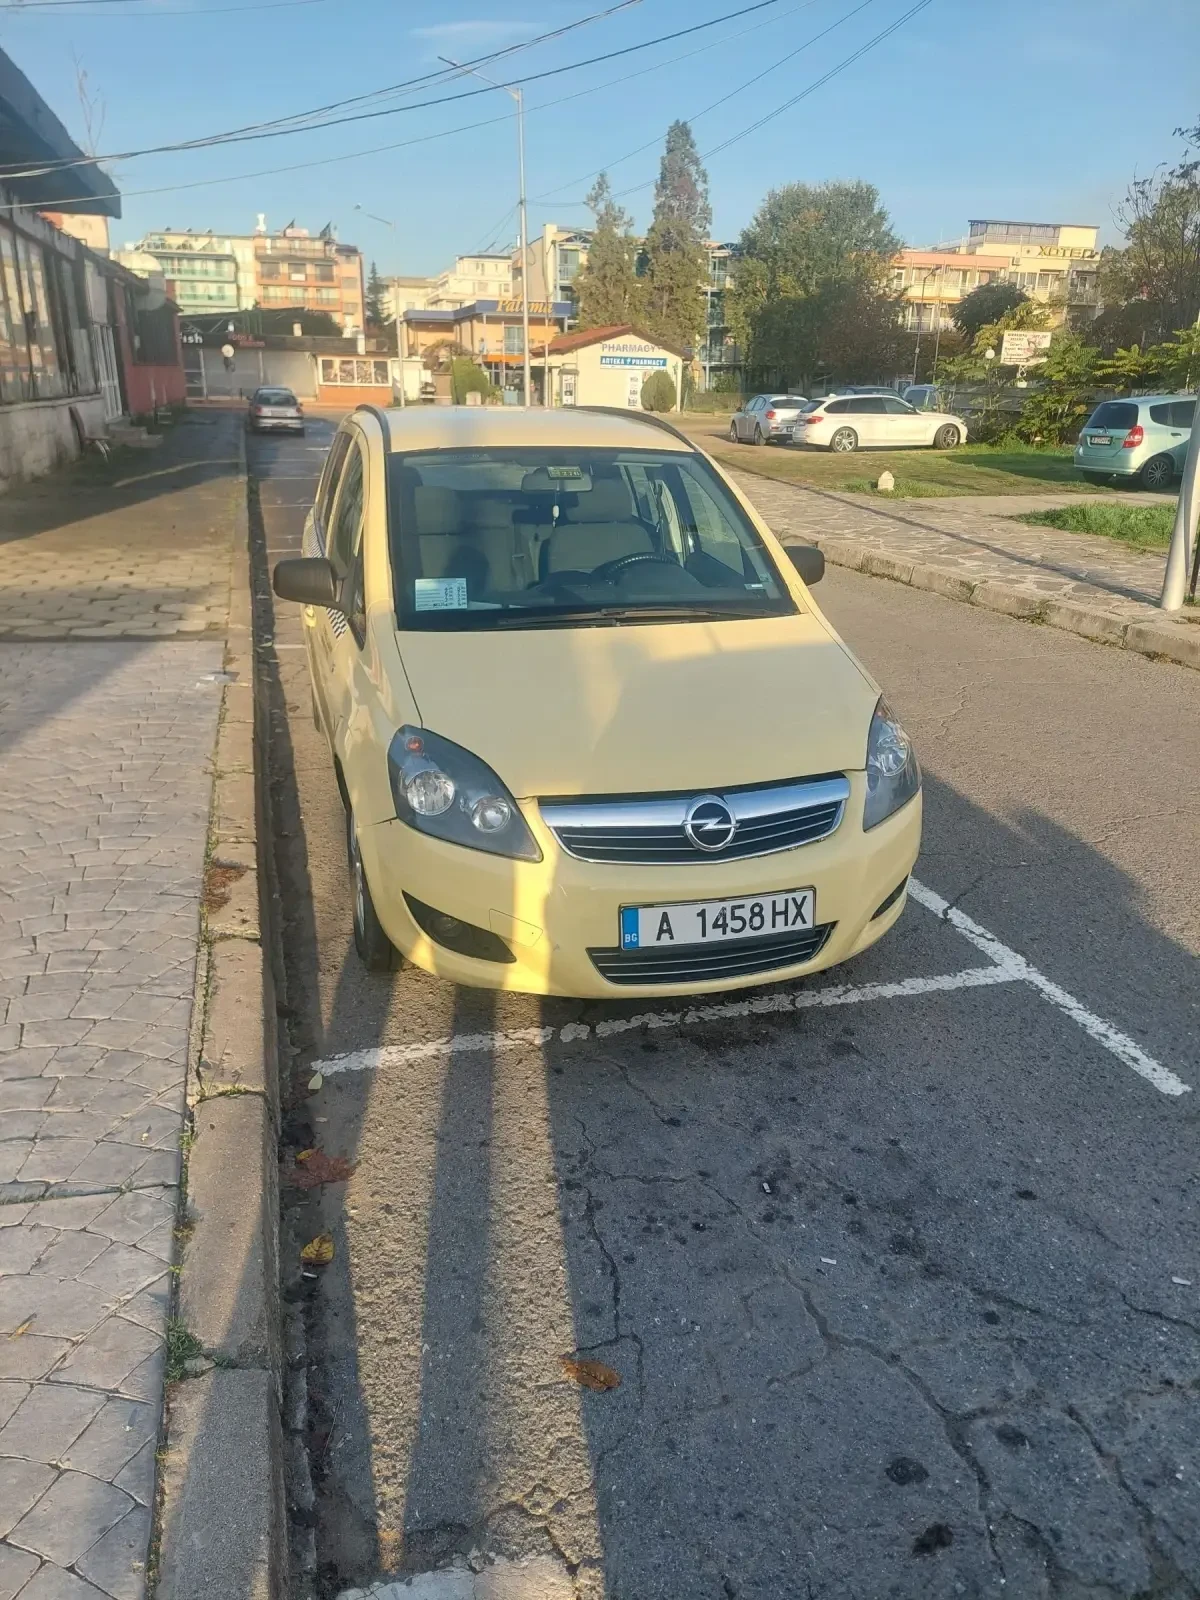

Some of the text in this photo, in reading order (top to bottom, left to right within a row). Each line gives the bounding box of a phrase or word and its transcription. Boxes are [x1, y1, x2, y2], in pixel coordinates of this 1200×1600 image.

[496, 294, 553, 313] Palma
[602, 343, 656, 353] PHARMACY
[602, 357, 664, 366] АПТЕКА PHARMACY
[624, 895, 808, 943] BG A 1458 HX
